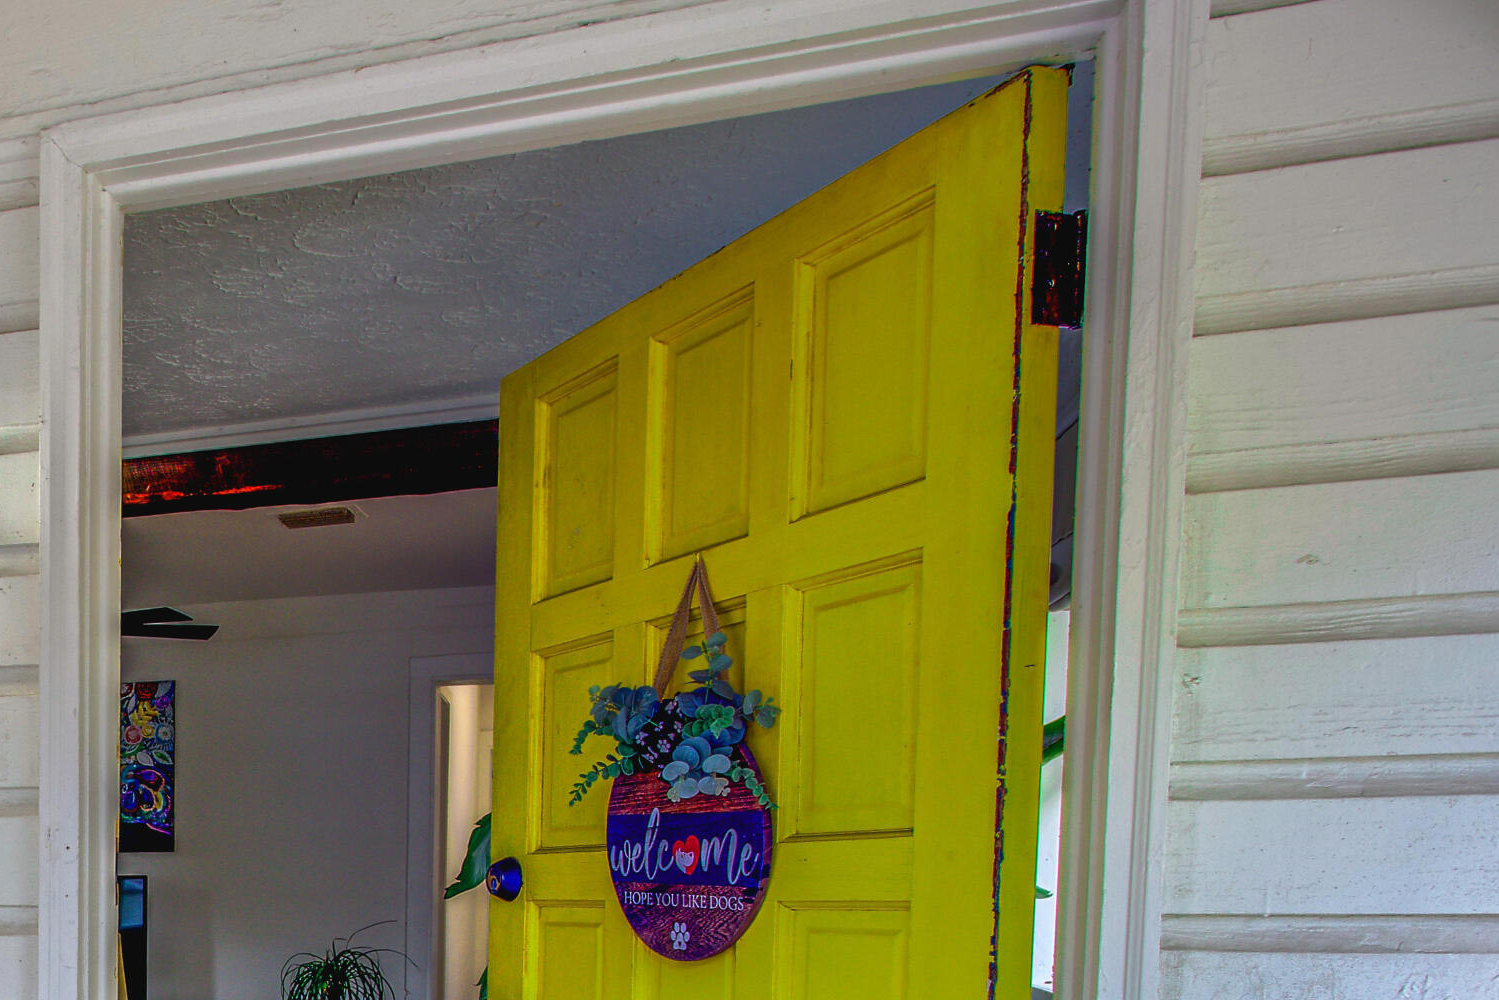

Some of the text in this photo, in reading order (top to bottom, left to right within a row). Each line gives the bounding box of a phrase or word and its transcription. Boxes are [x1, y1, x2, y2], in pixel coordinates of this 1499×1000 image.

[623, 891, 744, 912] HOPE YOU LIKE DOGS
